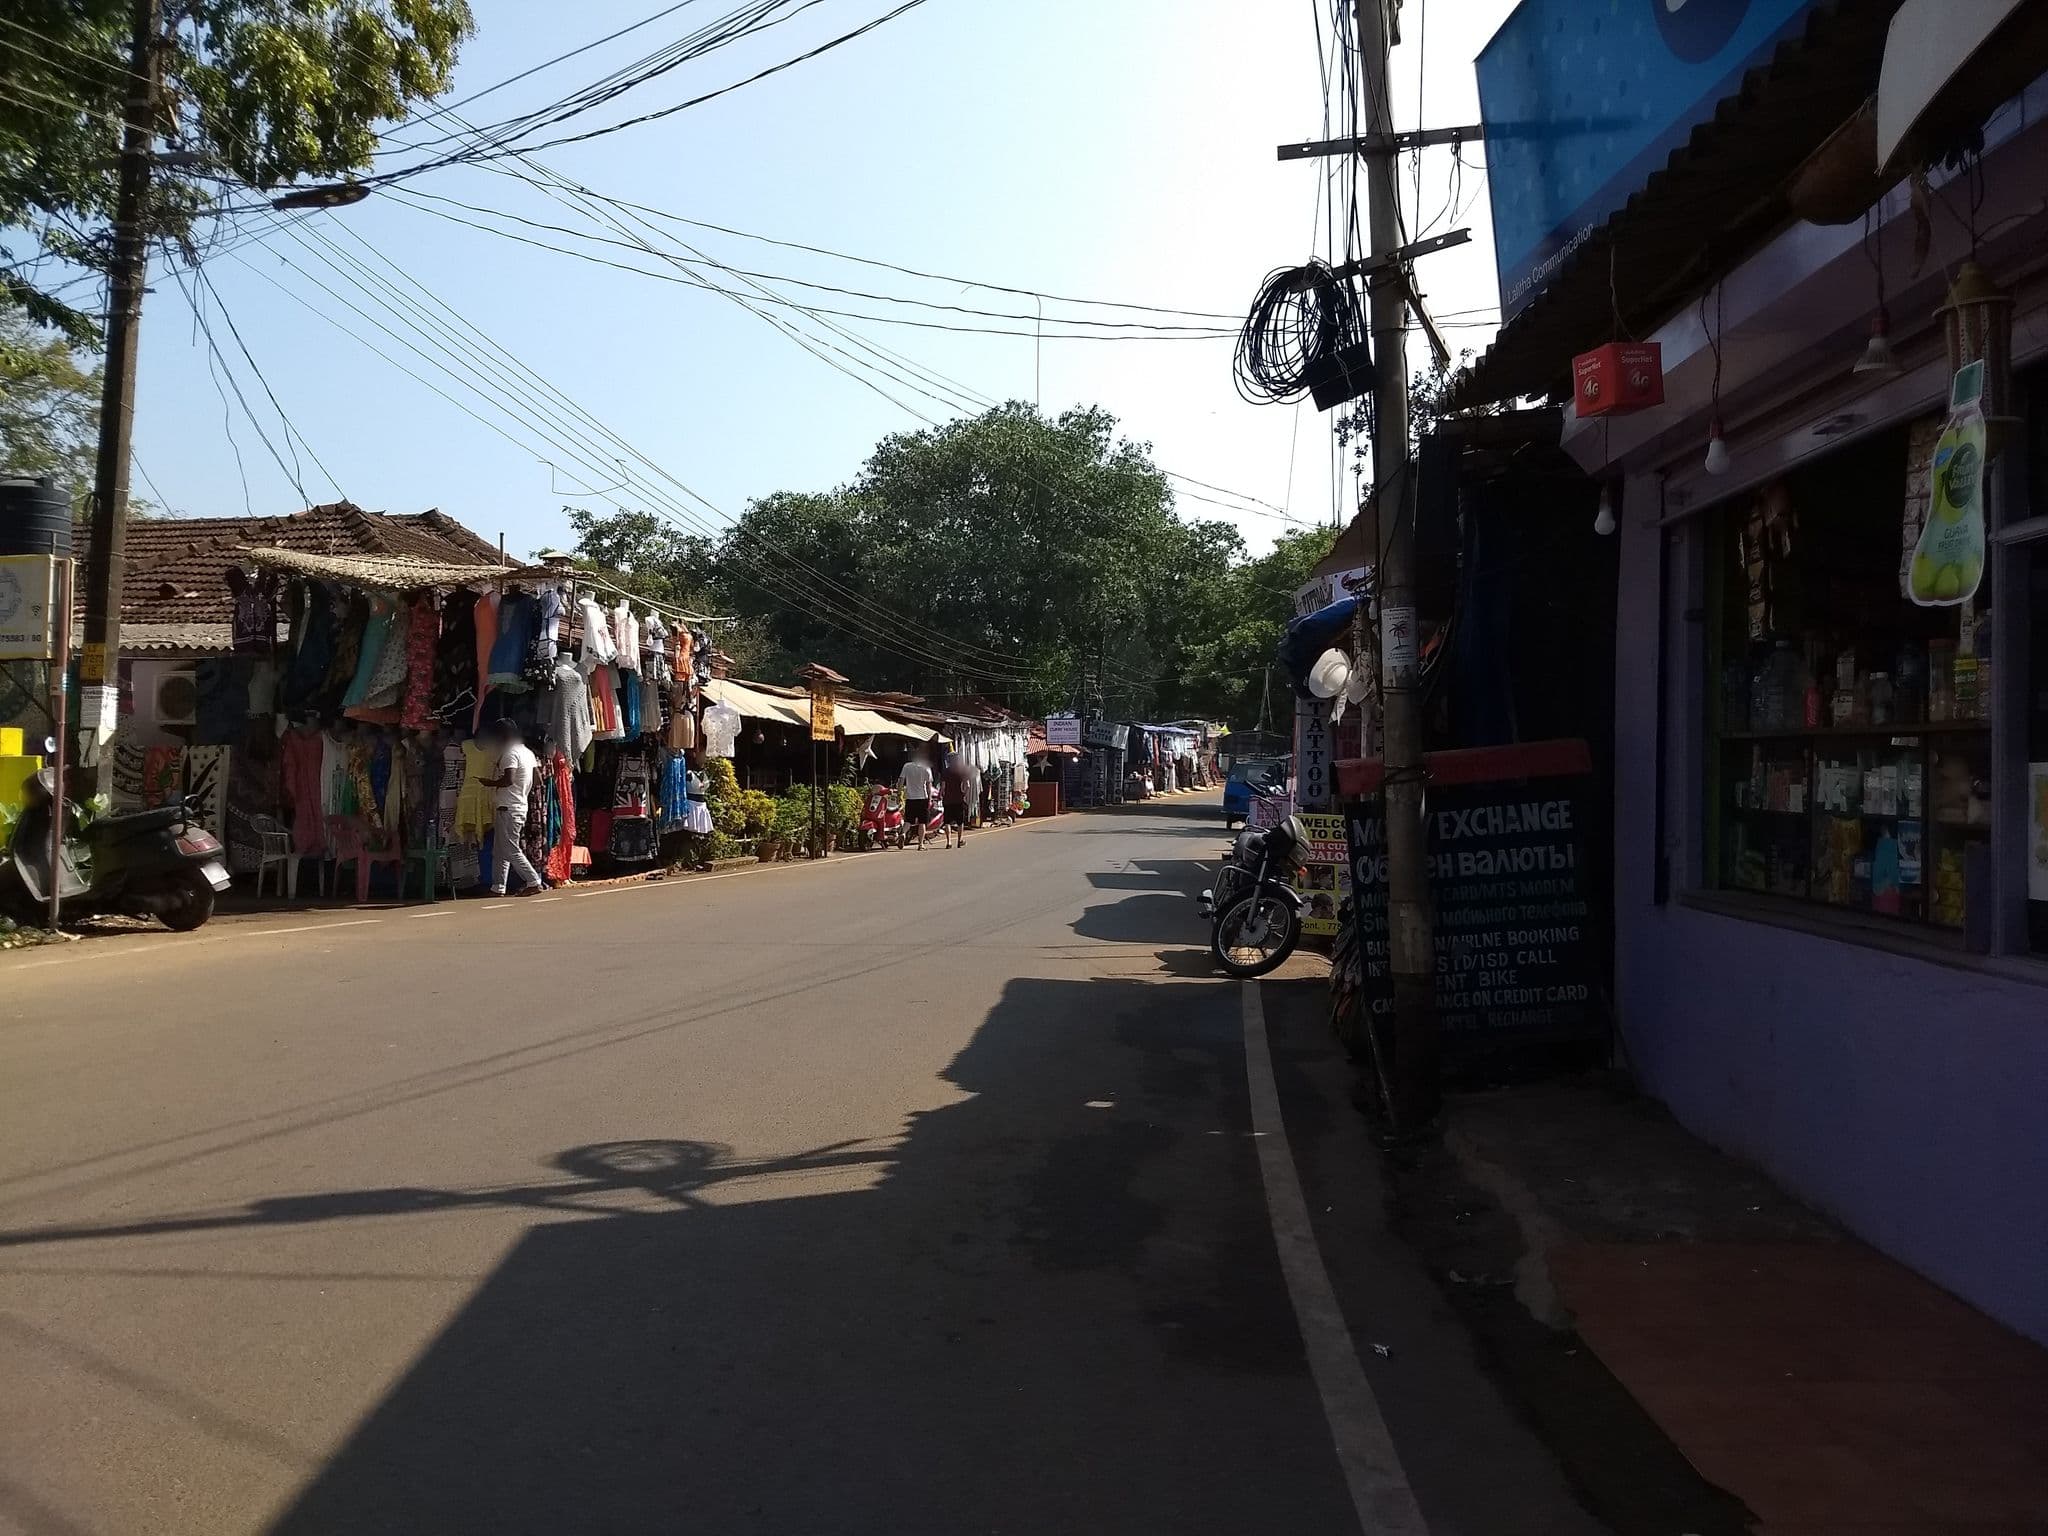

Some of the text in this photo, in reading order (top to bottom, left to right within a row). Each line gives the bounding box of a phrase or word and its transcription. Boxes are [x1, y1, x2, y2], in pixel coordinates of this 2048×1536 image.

[1507, 276, 1532, 304] Lalitha
[1307, 701, 1324, 798] TATTOO
[1438, 799, 1574, 840] EXCHANGE
[1310, 829, 1328, 839] TO
[1507, 926, 1581, 946] BOOKING
[1516, 949, 1558, 966] CALL
[1479, 969, 1519, 988] BIKE
[1472, 989, 1491, 1007] ON
[1494, 987, 1544, 1006] CREDIT
[1546, 984, 1589, 1002] CARD
